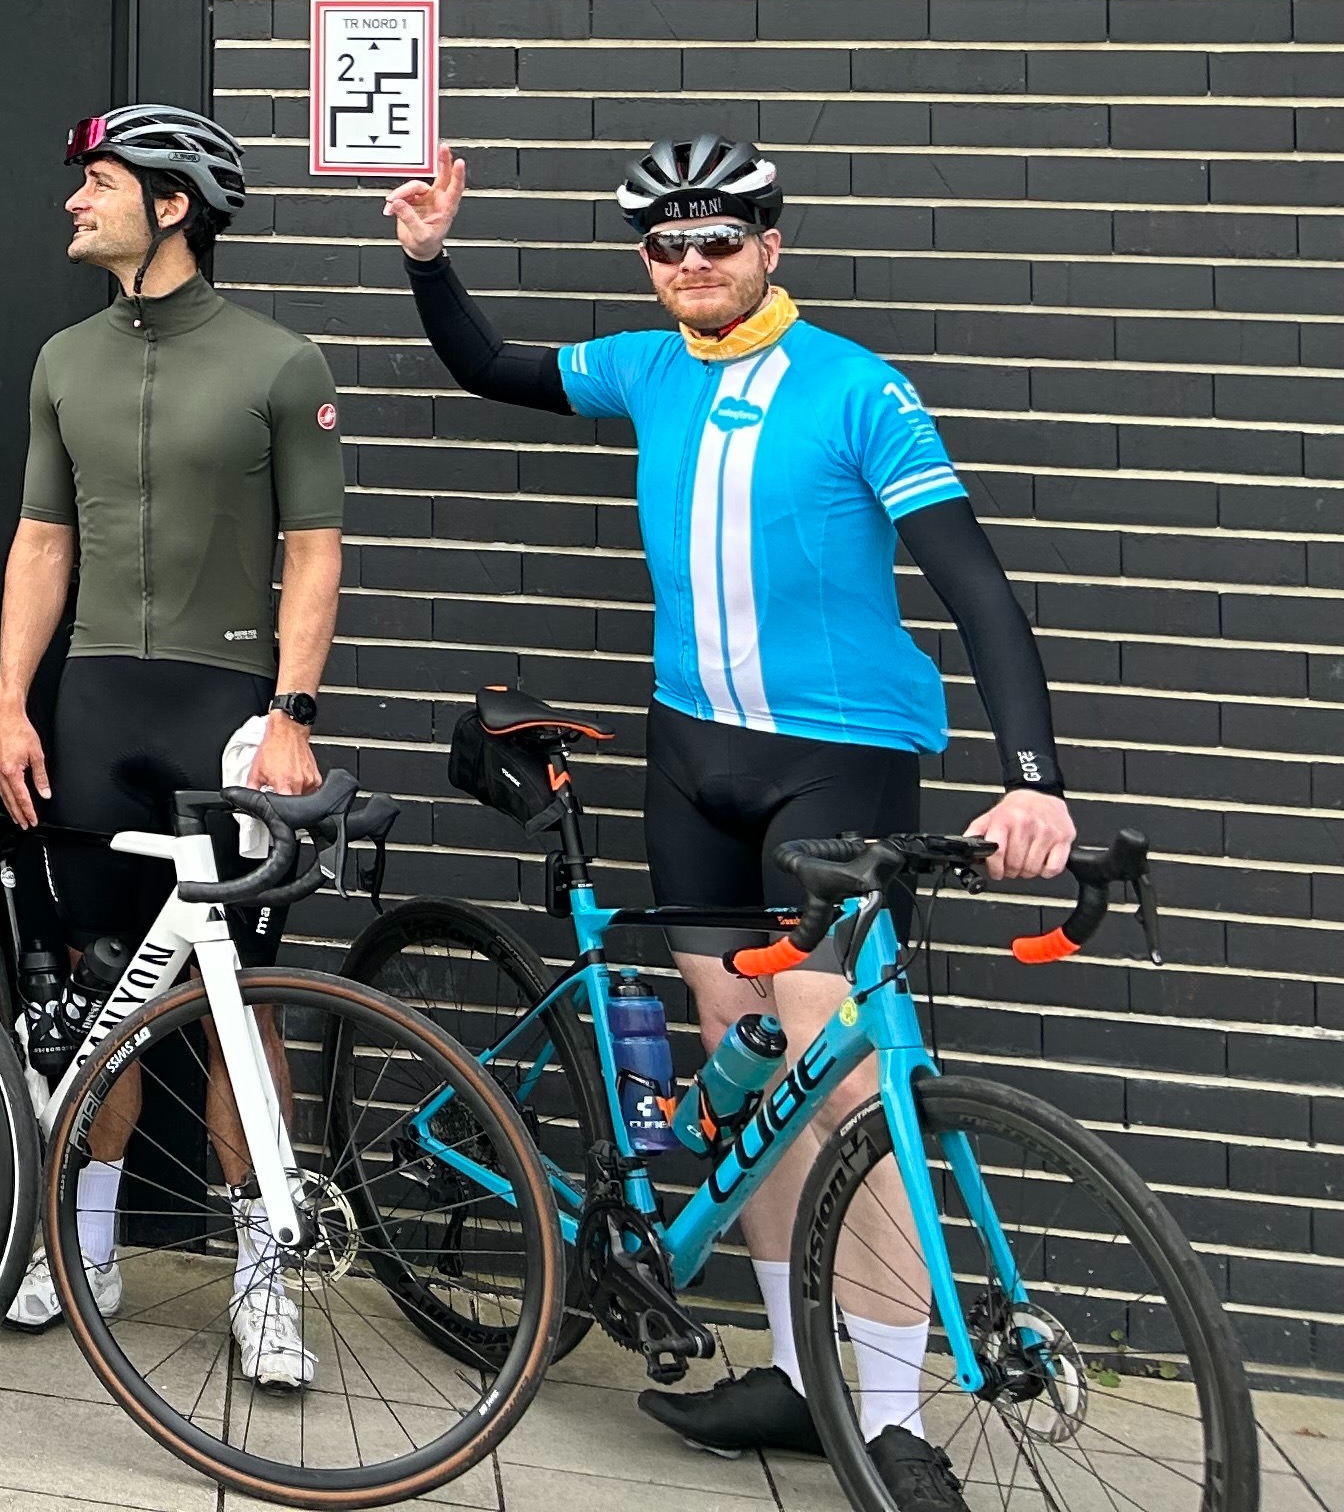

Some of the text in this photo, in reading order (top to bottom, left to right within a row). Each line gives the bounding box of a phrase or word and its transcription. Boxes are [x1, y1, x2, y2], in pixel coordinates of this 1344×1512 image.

[342, 18, 407, 30] TR NORD 1
[336, 53, 365, 82] 2.
[388, 103, 410, 135] E
[664, 196, 722, 218] JA MAN!
[105, 1043, 135, 1073] SWISS
[708, 1028, 838, 1204] CUBE
